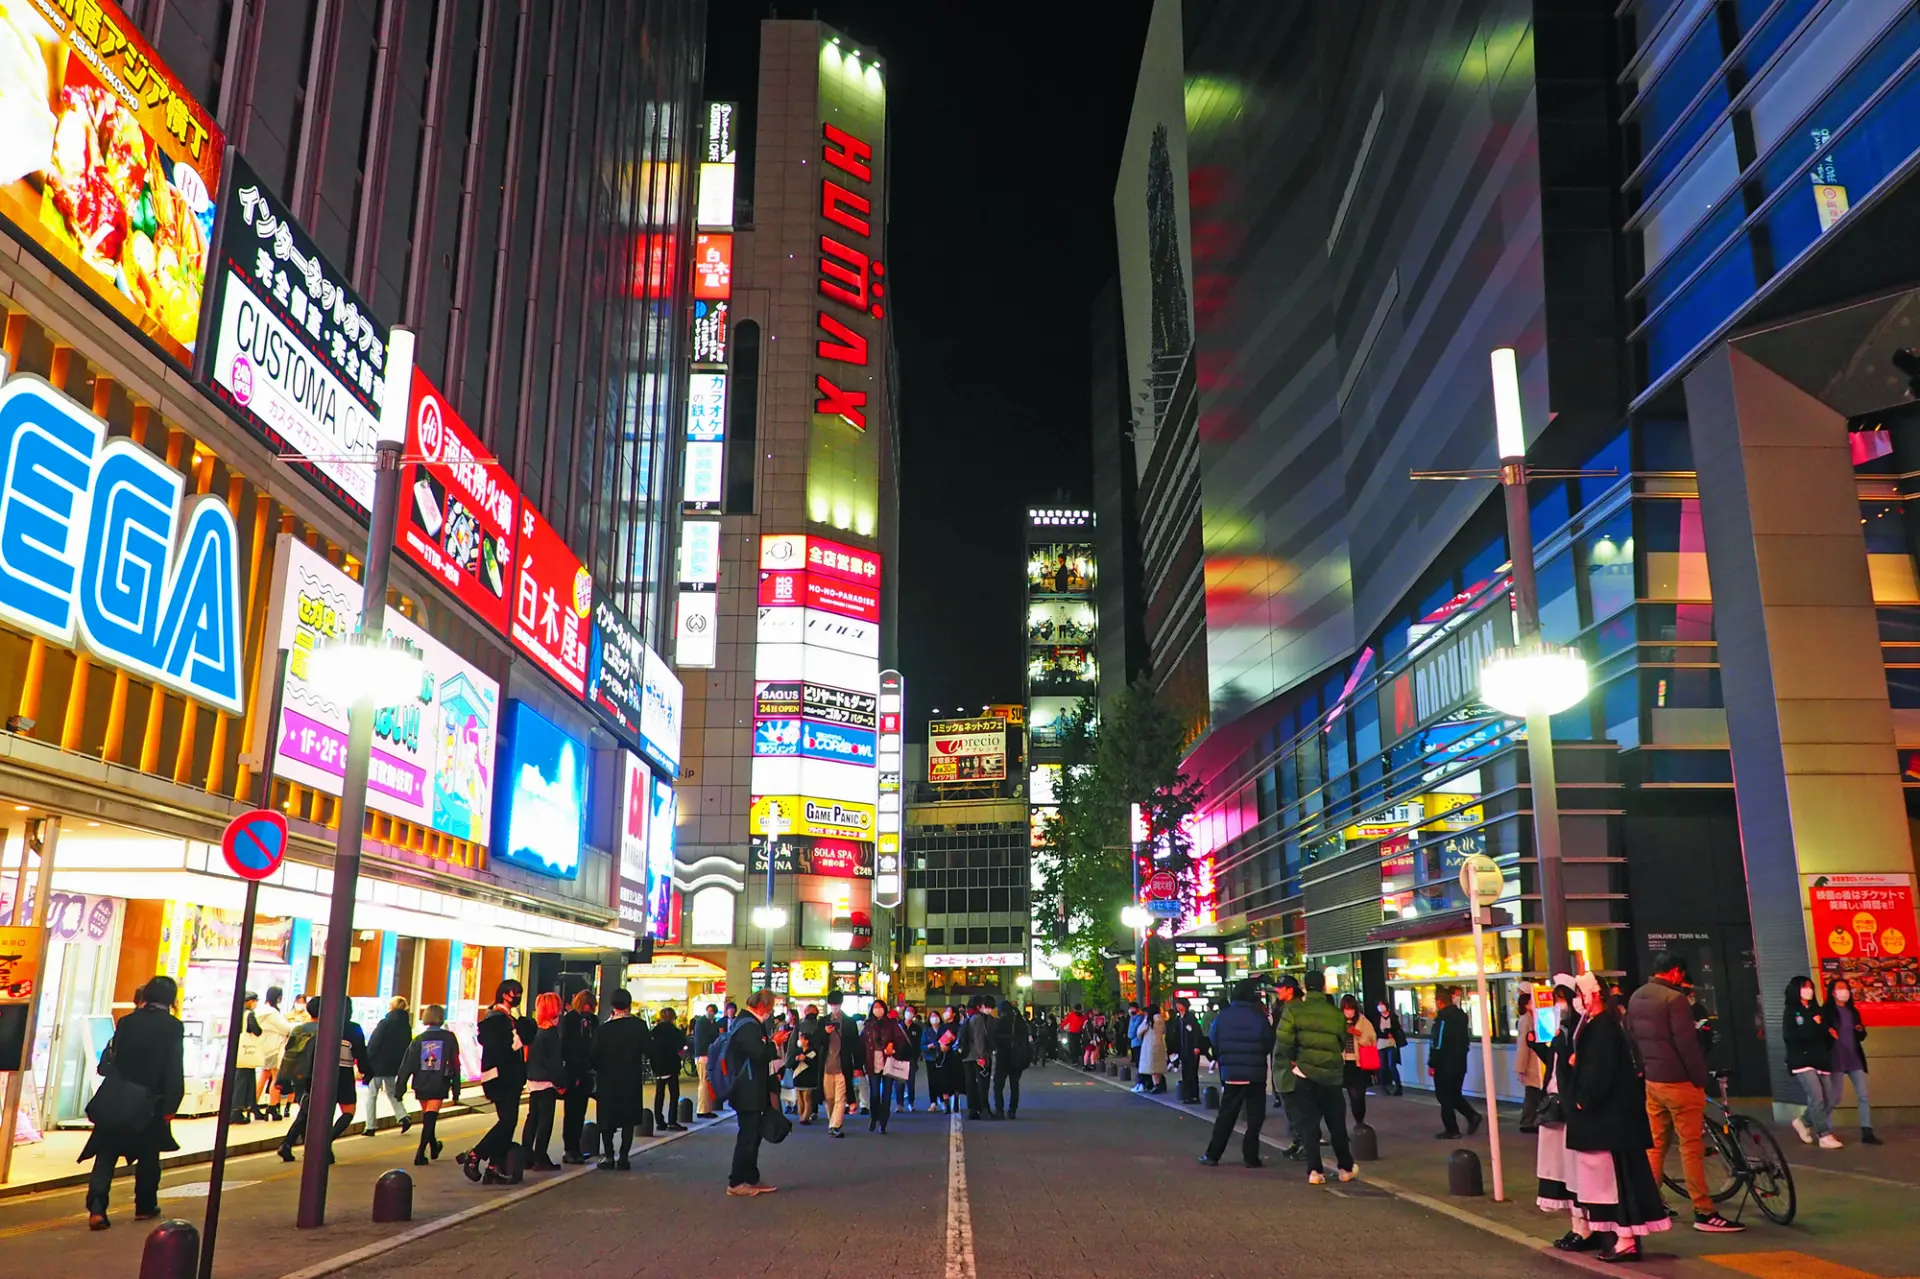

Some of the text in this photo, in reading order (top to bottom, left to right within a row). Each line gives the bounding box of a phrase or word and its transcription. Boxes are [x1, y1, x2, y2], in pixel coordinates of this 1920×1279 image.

[69, 30, 98, 67] ASIAN
[97, 59, 139, 111] YOKOCHO
[238, 185, 384, 370] インターネットカフェ
[237, 300, 379, 464] CUSTOMA CAF
[691, 394, 706, 432] の鉄人
[708, 376, 723, 432] カラオケ
[522, 509, 536, 539] 5F
[496, 536, 511, 567] 6F
[691, 583, 705, 591] 1F
[808, 584, 875, 607] MO-MO-PARADISE
[517, 554, 580, 669] 白木屋
[596, 601, 632, 655] インターネット
[1416, 619, 1496, 724] MARUHAN
[761, 690, 799, 700] BAGUS
[778, 704, 799, 713] OPEN
[803, 685, 875, 713] ビリヤード&ダーツ
[825, 707, 850, 722] ゴルフ
[931, 721, 1003, 733] コミック&ネットカフェ
[806, 802, 859, 825] GAME PANIC
[814, 847, 853, 859] SOLA SPA
